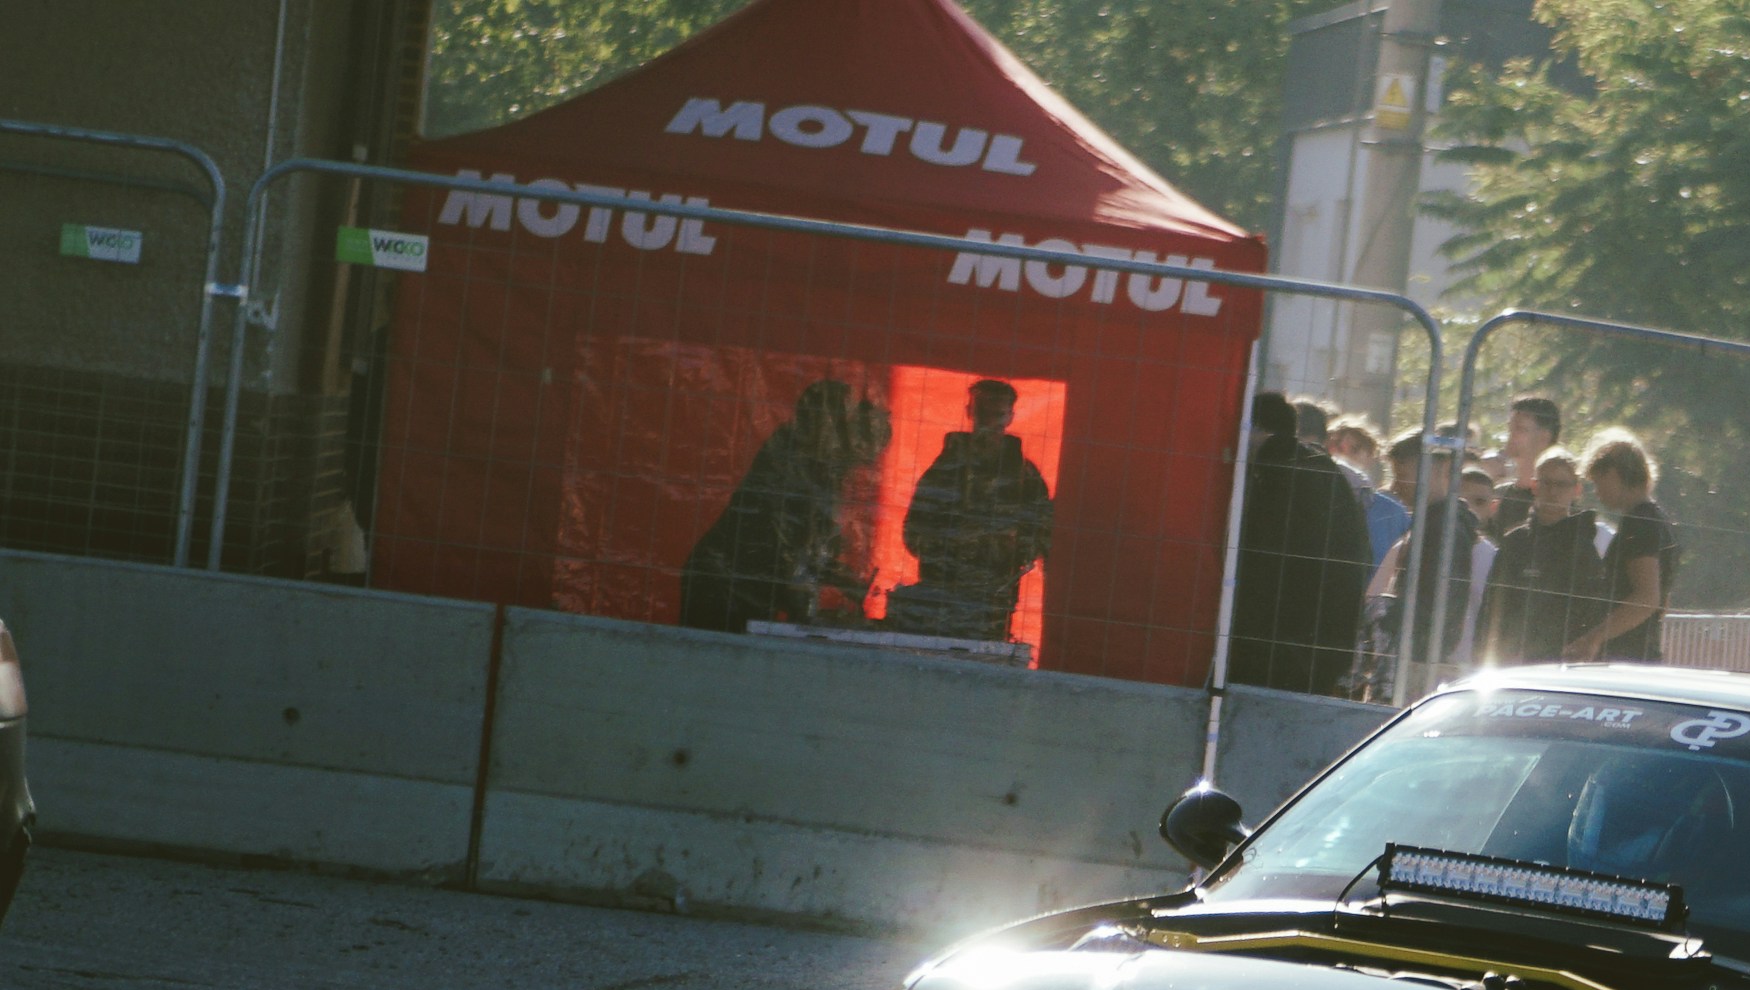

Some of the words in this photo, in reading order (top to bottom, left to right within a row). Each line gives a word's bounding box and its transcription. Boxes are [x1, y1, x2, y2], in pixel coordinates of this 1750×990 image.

[664, 98, 1036, 177] MOTUL
[437, 169, 717, 255] MOTUL
[946, 228, 1223, 317] MOTUL
[1473, 704, 1643, 724] PACE-ART
